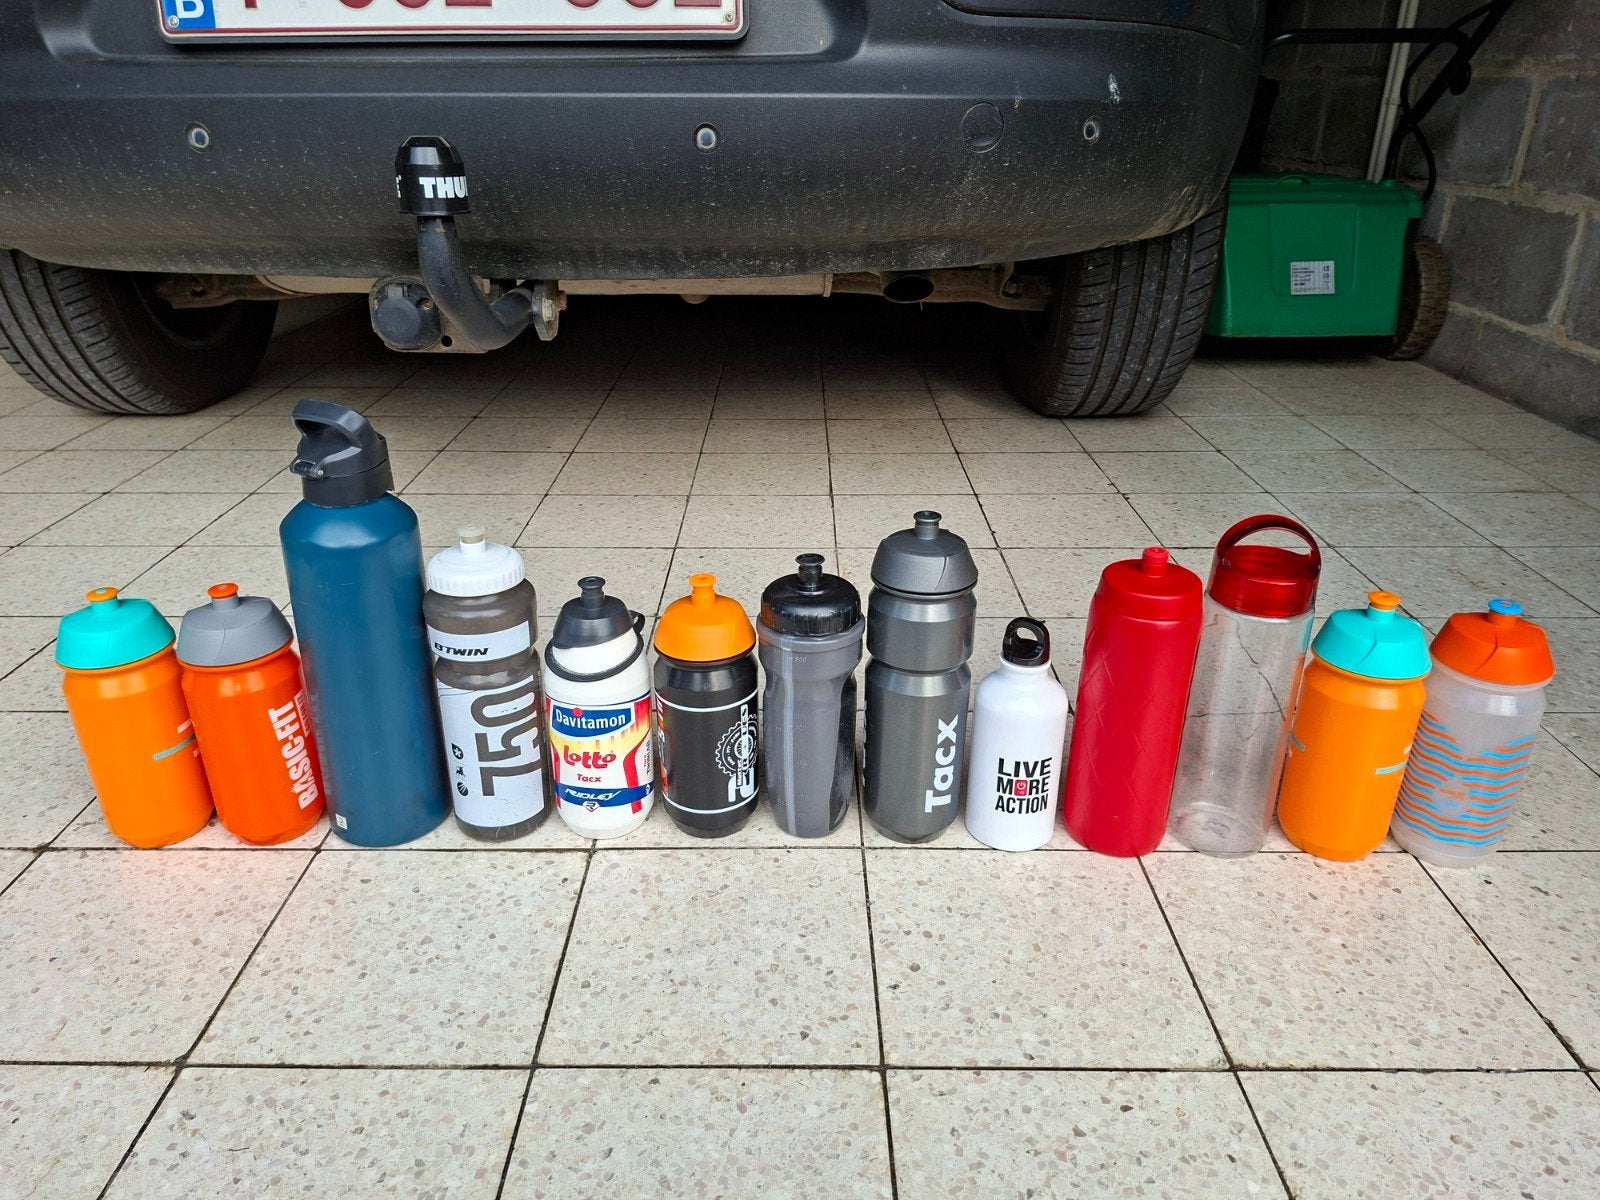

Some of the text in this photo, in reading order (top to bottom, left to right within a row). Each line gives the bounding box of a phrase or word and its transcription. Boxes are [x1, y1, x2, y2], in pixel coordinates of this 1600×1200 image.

[418, 175, 469, 199] THU
[555, 708, 626, 729] Davitamon
[470, 676, 542, 797] 750
[268, 700, 319, 810] BASIC-FIT
[924, 714, 959, 813] Tacx
[577, 773, 602, 782] Tacx
[998, 757, 1052, 777] LIVE
[565, 788, 622, 800] RIDLEY
[995, 793, 1048, 814] ACTION
